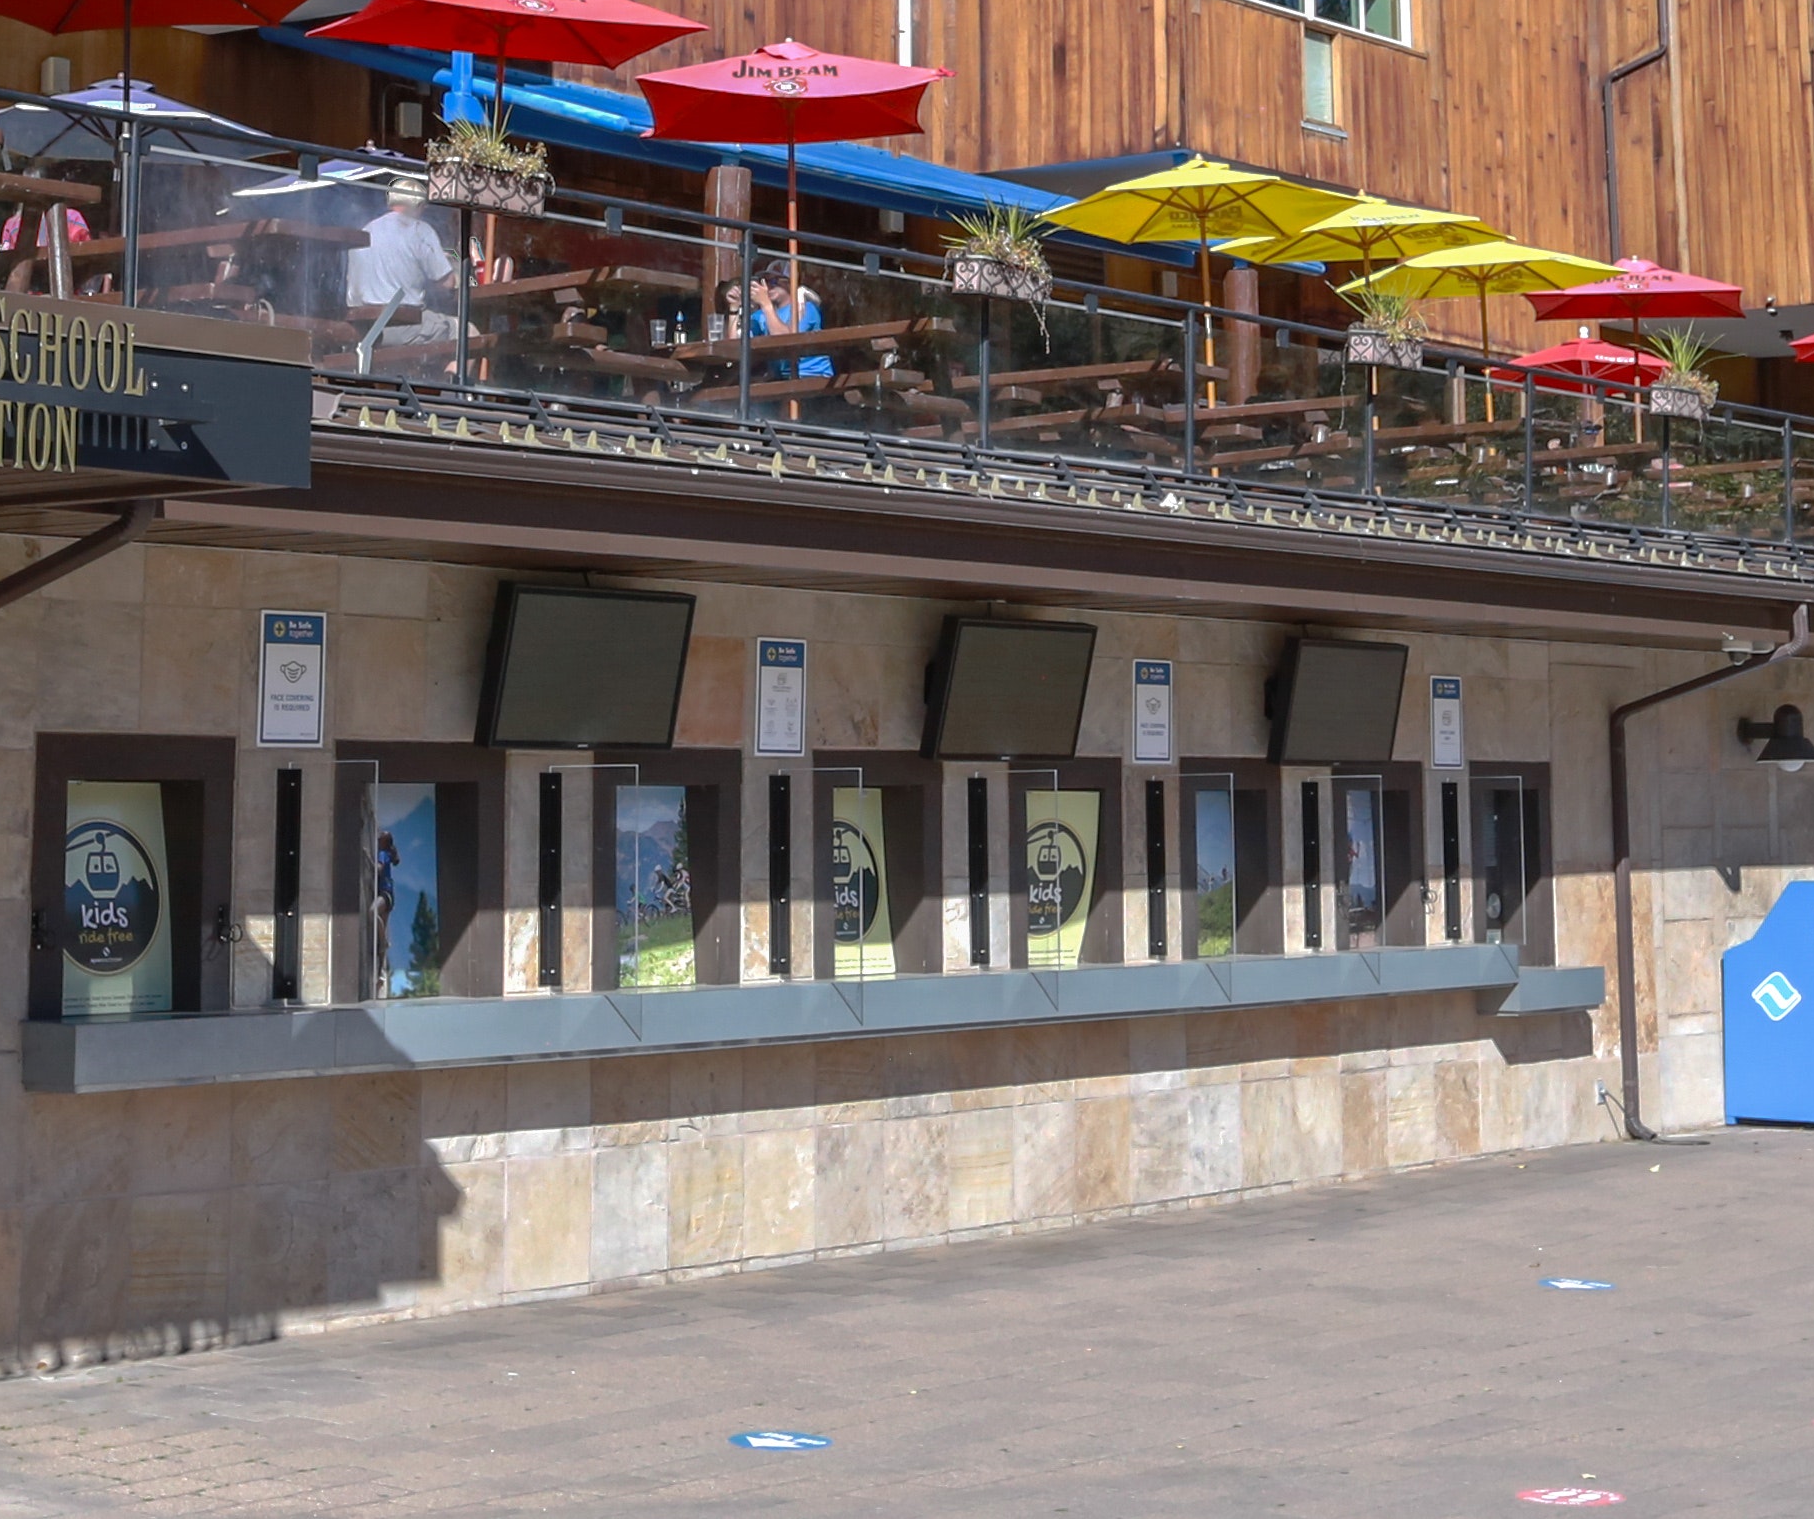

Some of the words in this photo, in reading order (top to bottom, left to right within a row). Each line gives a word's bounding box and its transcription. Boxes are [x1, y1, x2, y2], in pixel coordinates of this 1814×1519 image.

[732, 60, 772, 78] JIM
[778, 64, 838, 77] BEAM
[833, 885, 858, 908] ids
[1029, 882, 1062, 904] kids
[81, 901, 129, 929] kids
[79, 930, 105, 944] ride
[107, 927, 134, 945] free
